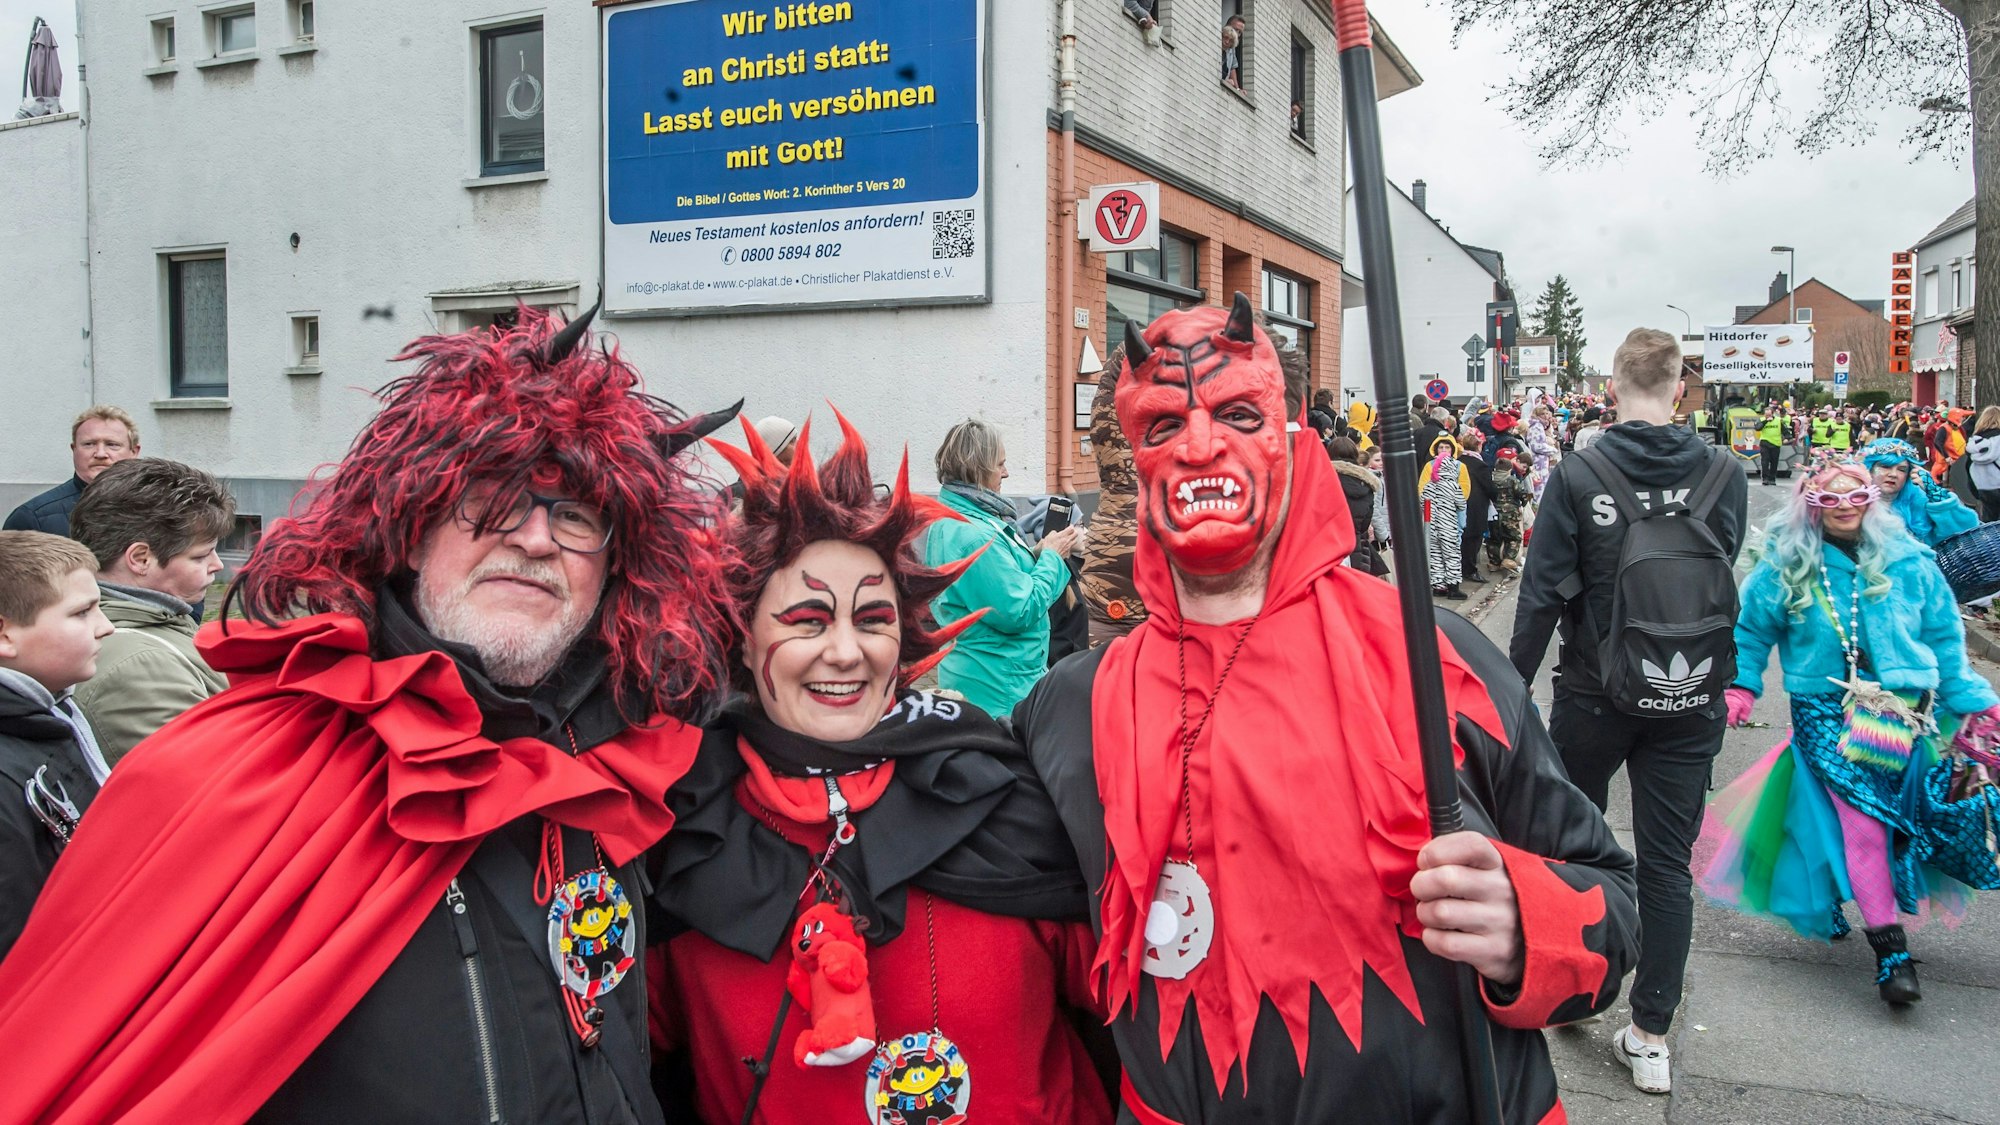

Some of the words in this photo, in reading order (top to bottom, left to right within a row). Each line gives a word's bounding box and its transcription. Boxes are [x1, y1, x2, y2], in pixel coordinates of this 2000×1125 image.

[722, 9, 767, 37] Wir
[774, 1, 852, 30] bitten
[682, 65, 713, 88] an
[721, 50, 806, 83] Christi
[814, 40, 889, 71] statt:
[643, 106, 712, 135] Lasst
[720, 99, 783, 127] euch
[789, 84, 935, 119] versöhnen
[726, 143, 769, 169] mit
[777, 136, 845, 164] Gott!
[676, 195, 693, 207] Die
[695, 193, 720, 206] Bibel
[722, 191, 726, 204] /
[728, 190, 761, 203] Gottes
[763, 188, 790, 200] Wort:
[792, 187, 802, 199] 2.
[804, 182, 854, 197] Korinther
[856, 181, 863, 193] 5
[865, 179, 889, 192] Vers
[892, 177, 906, 190] 20
[649, 230, 691, 244] Neues
[695, 223, 766, 242] Testament
[769, 218, 839, 237] kostenlos
[843, 211, 925, 232] anfordern!
[741, 248, 774, 263] 0800
[777, 246, 811, 260] 5894
[815, 243, 842, 258] 802
[626, 280, 705, 295] info@c-plakat.de
[712, 275, 793, 290] www.c-plakat.de
[801, 272, 860, 286] Christlicher
[863, 268, 930, 283] Plakatdienst
[933, 267, 955, 280] e.V.
[1894, 252, 1910, 371] BÄCKEREI
[1709, 332, 1768, 341] Hitdorfer
[1704, 361, 1815, 371] Geselligkeitsverein
[1749, 372, 1771, 380] e.V.
[1836, 374, 1846, 383] P
[1638, 694, 1710, 711] adidas
[578, 924, 624, 956] TEUFEL
[897, 1083, 954, 1111] TEUFEL
